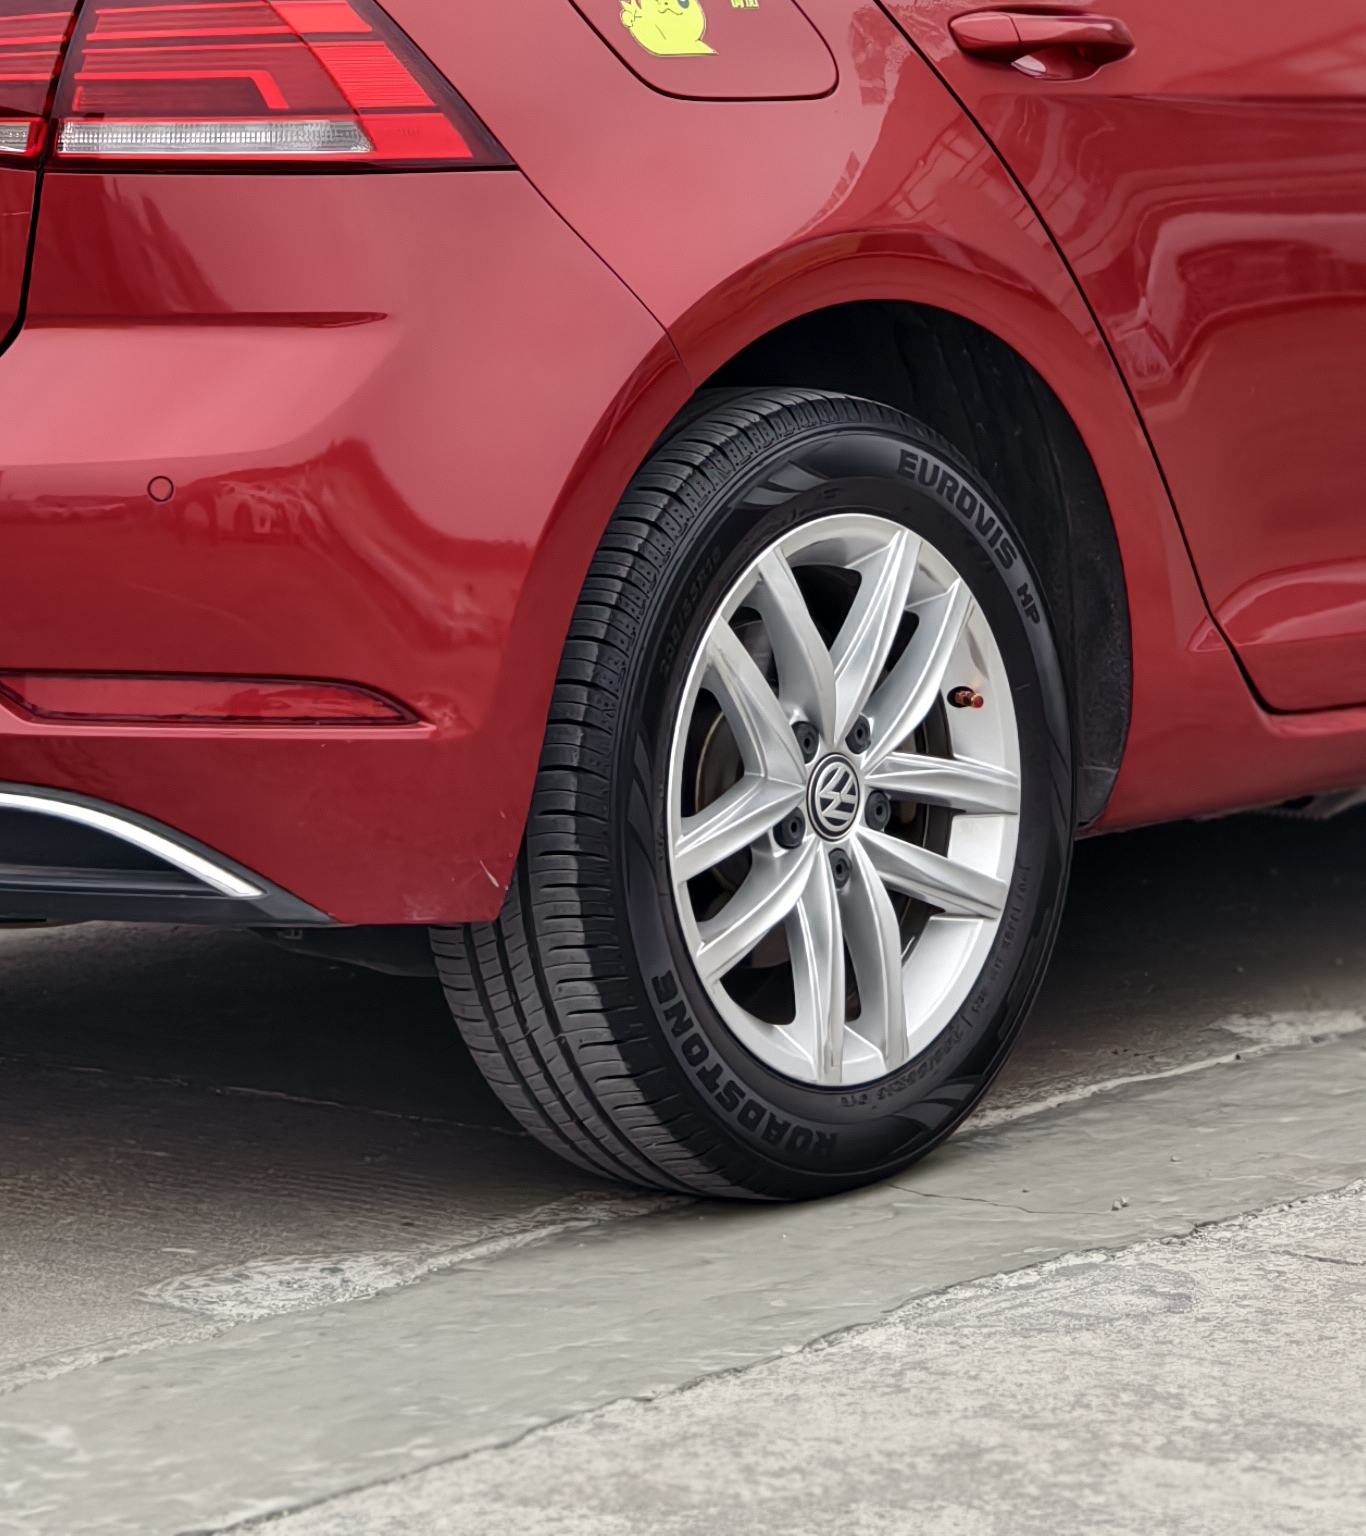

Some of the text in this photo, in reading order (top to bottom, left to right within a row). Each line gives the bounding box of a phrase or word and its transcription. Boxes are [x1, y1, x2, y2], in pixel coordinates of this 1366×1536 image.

[897, 449, 1041, 625] EUROVIS HP
[651, 970, 838, 1158] ROADSTONE
